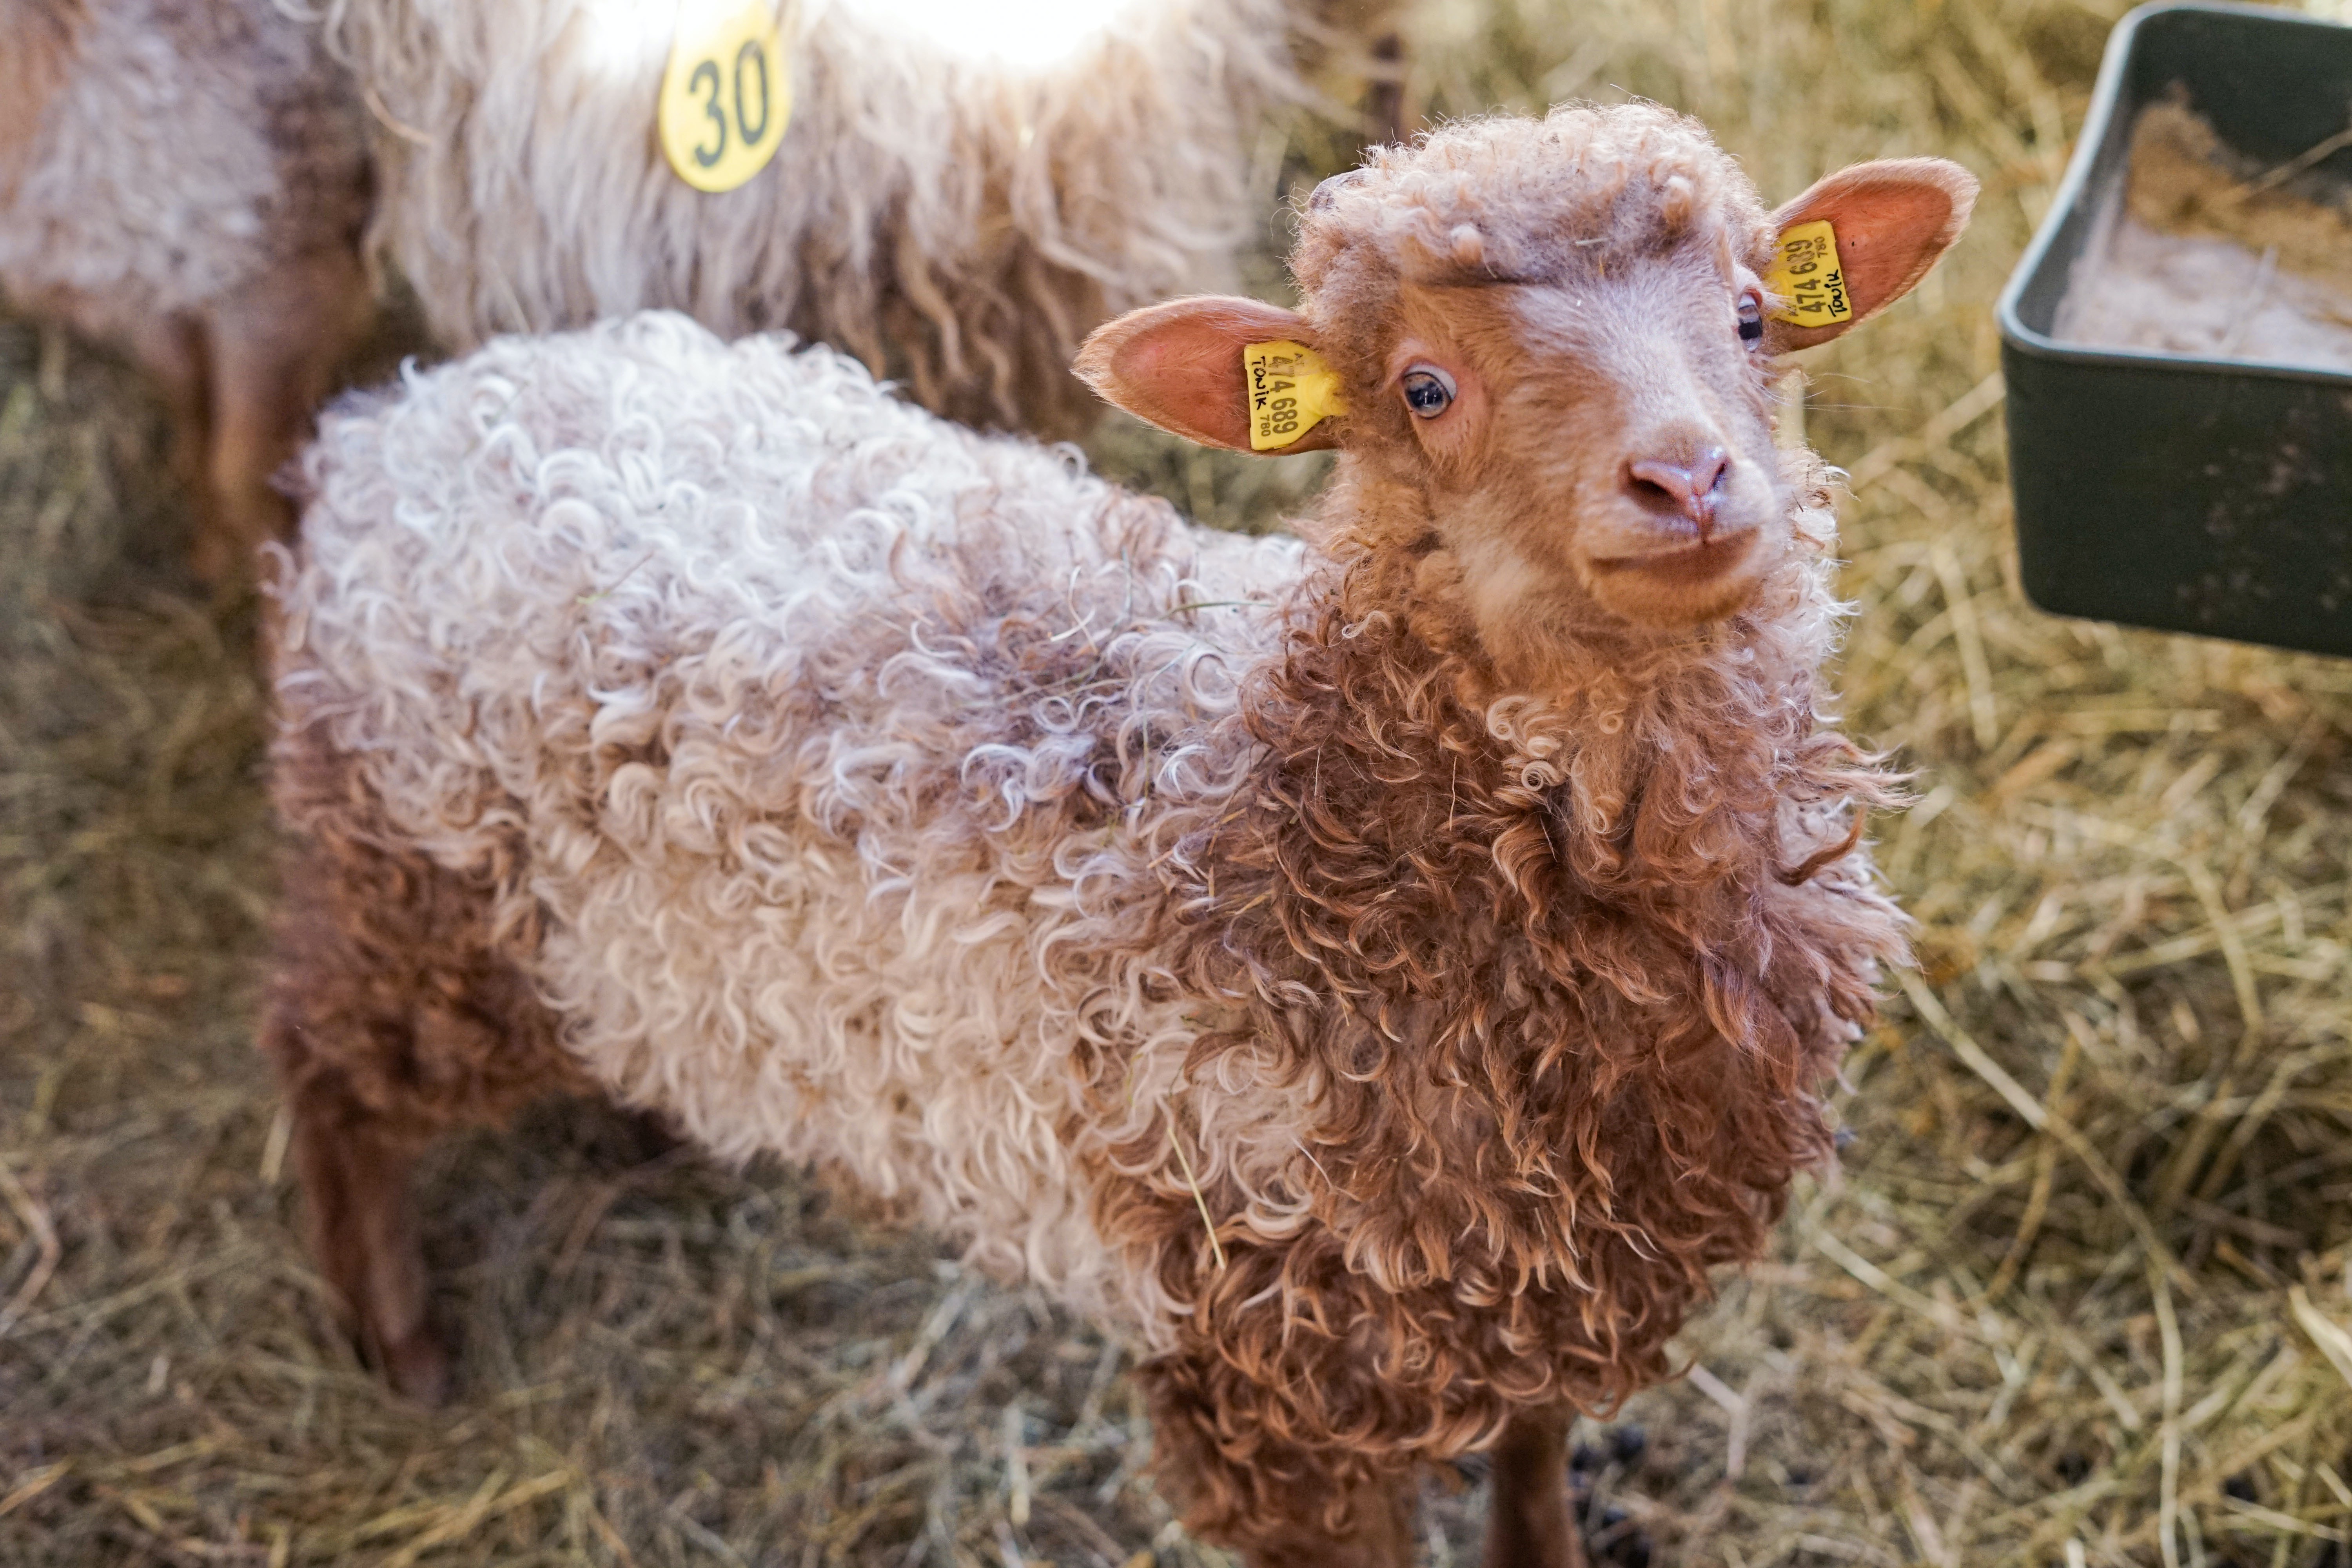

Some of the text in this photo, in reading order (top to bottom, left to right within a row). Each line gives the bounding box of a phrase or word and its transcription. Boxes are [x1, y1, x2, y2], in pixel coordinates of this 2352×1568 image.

[689, 38, 768, 167] 30
[1814, 236, 1828, 258] 780
[1785, 240, 1826, 312] 474 689
[1259, 414, 1271, 437] 780
[1271, 397, 1299, 434] 689
